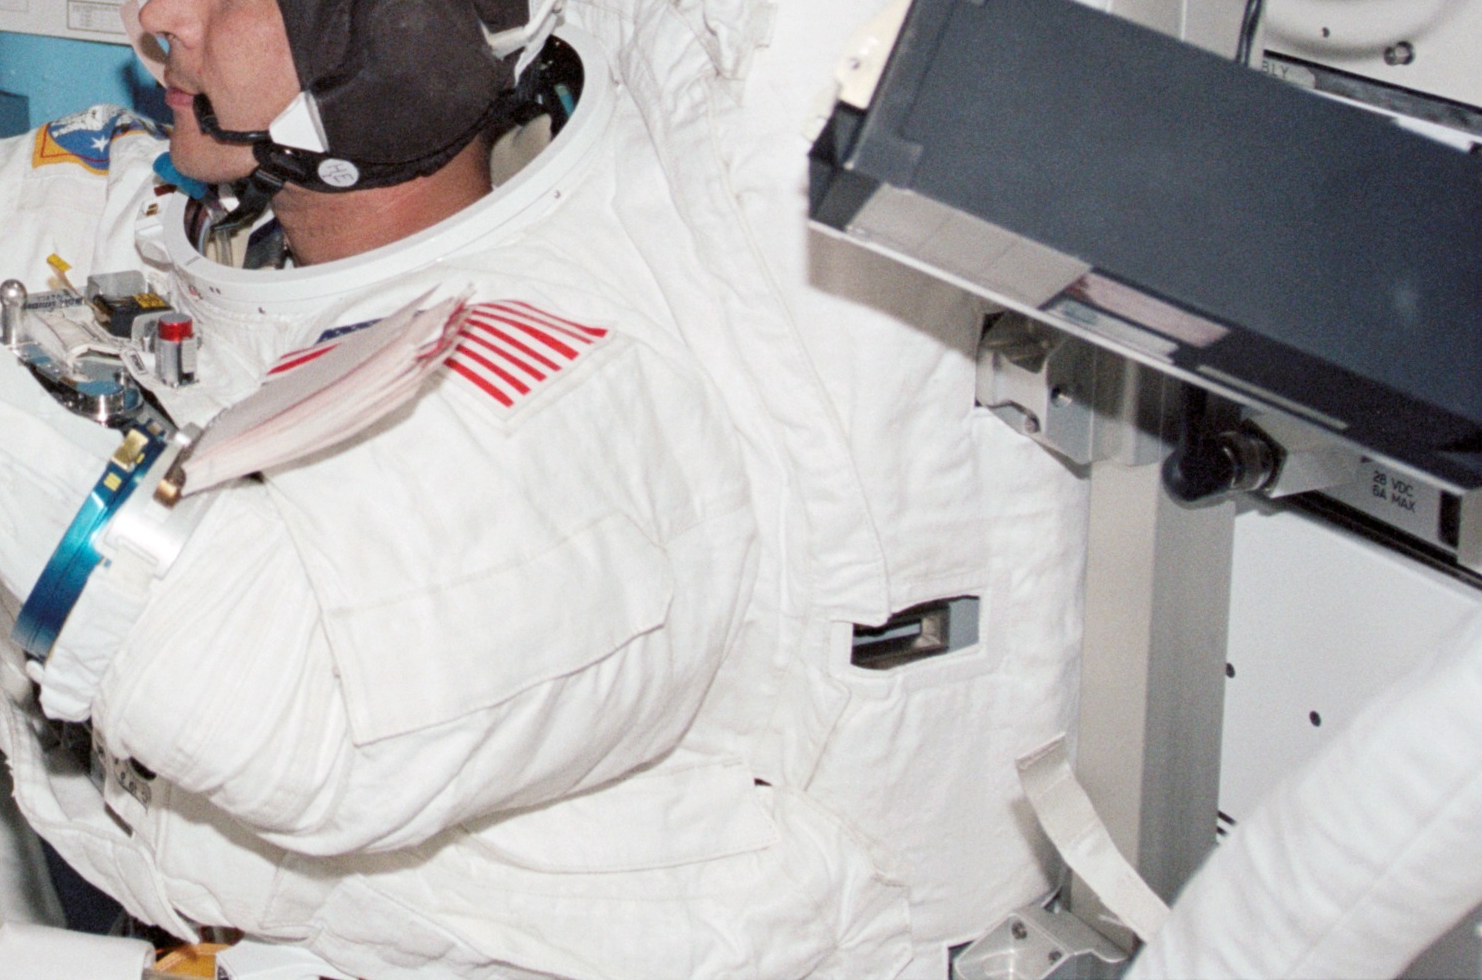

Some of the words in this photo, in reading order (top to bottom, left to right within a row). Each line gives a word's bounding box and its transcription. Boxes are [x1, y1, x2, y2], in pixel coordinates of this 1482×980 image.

[1373, 470, 1387, 486] 28
[1391, 477, 1414, 497] VDC
[1391, 492, 1416, 513] MAX
